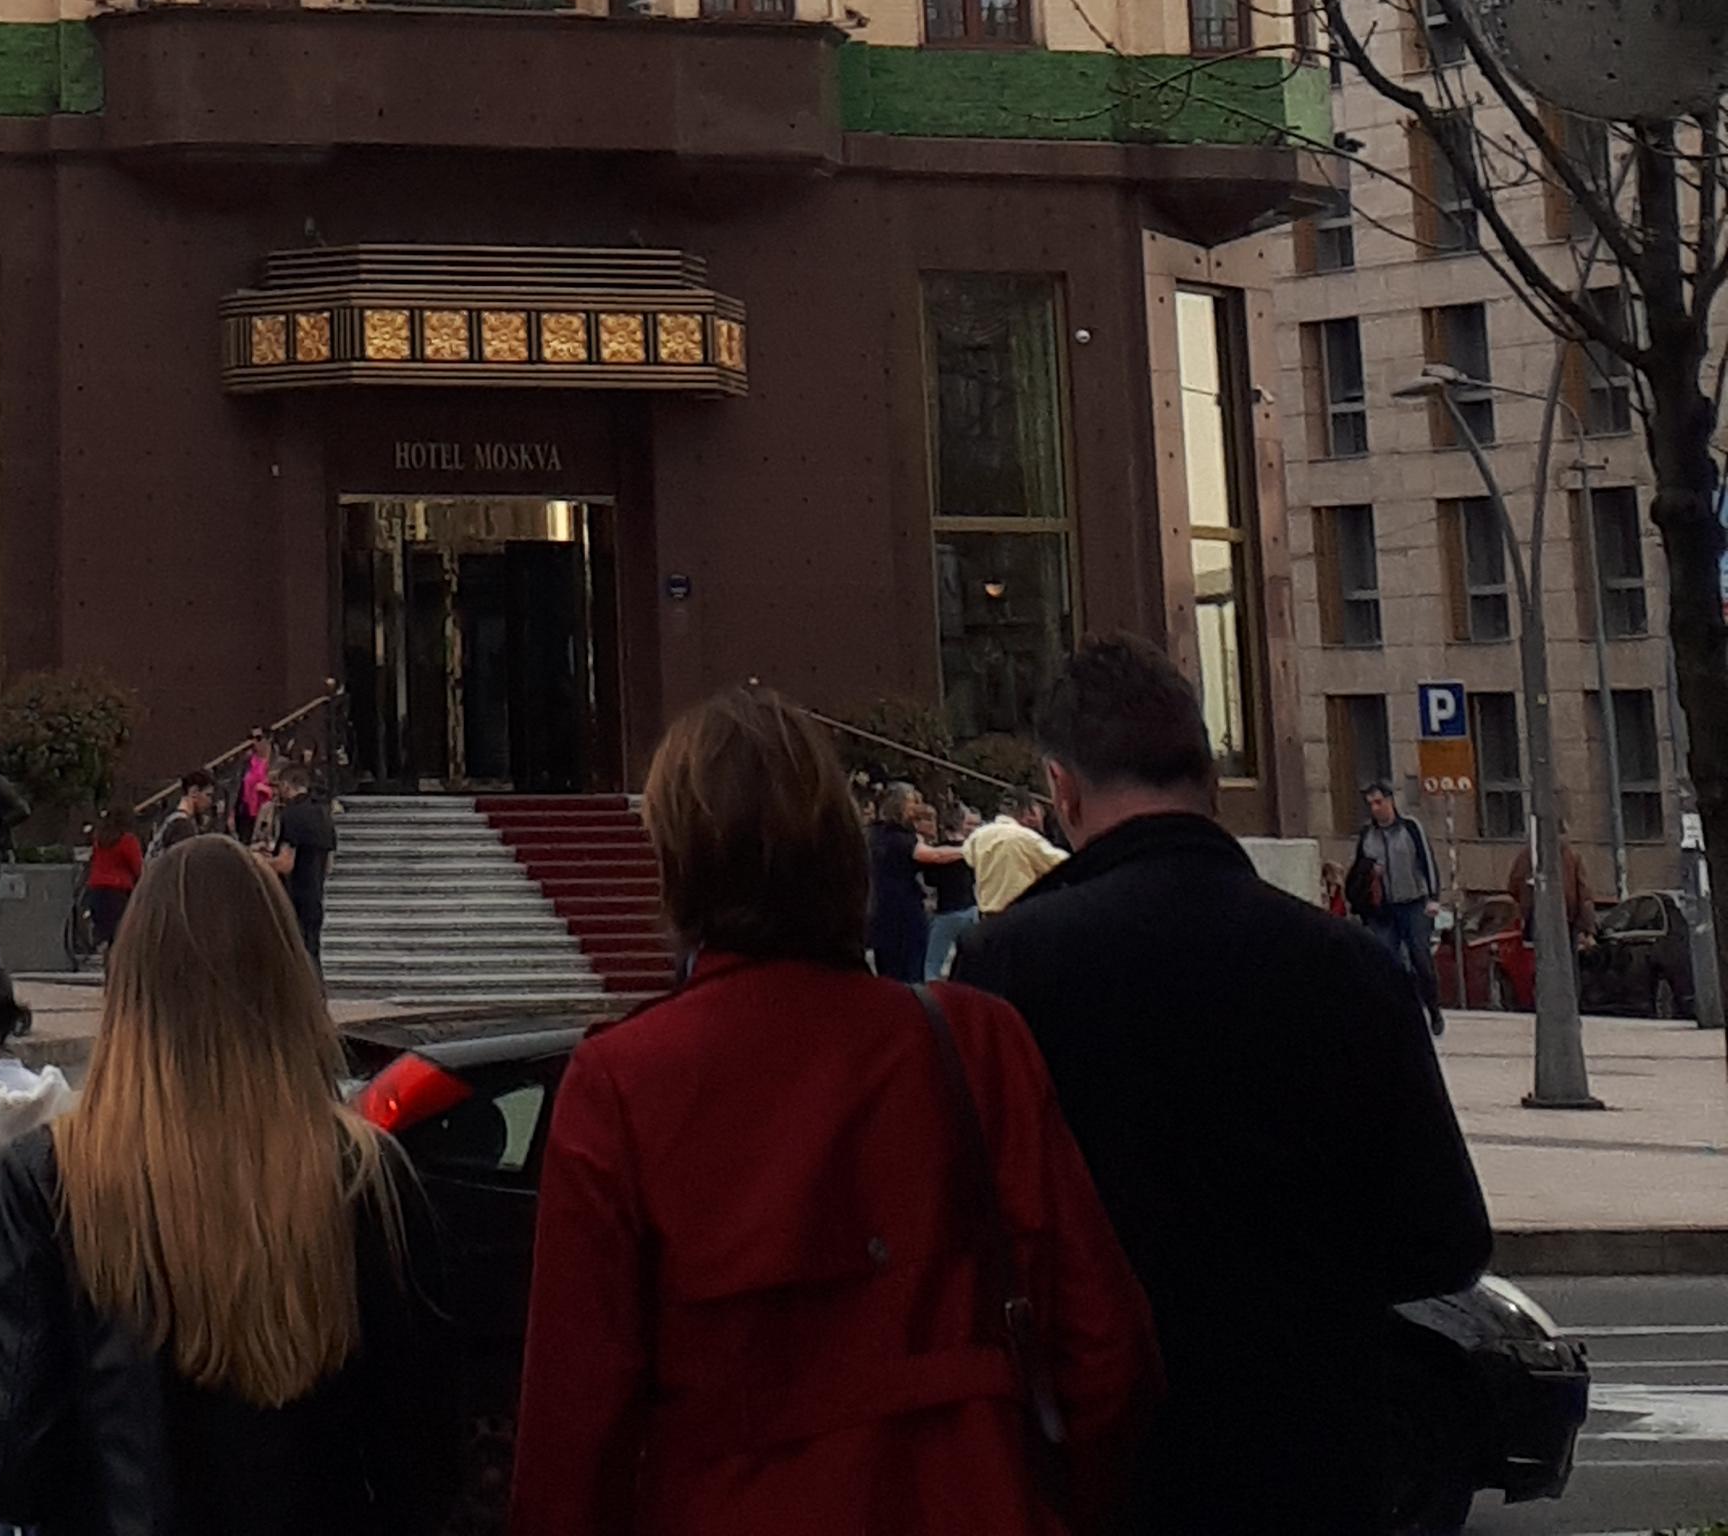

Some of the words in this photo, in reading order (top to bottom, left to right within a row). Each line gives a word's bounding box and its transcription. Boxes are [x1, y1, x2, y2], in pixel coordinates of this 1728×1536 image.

[394, 441, 465, 470] HOTEL
[474, 442, 562, 472] MOSKVA
[1427, 689, 1456, 733] P
